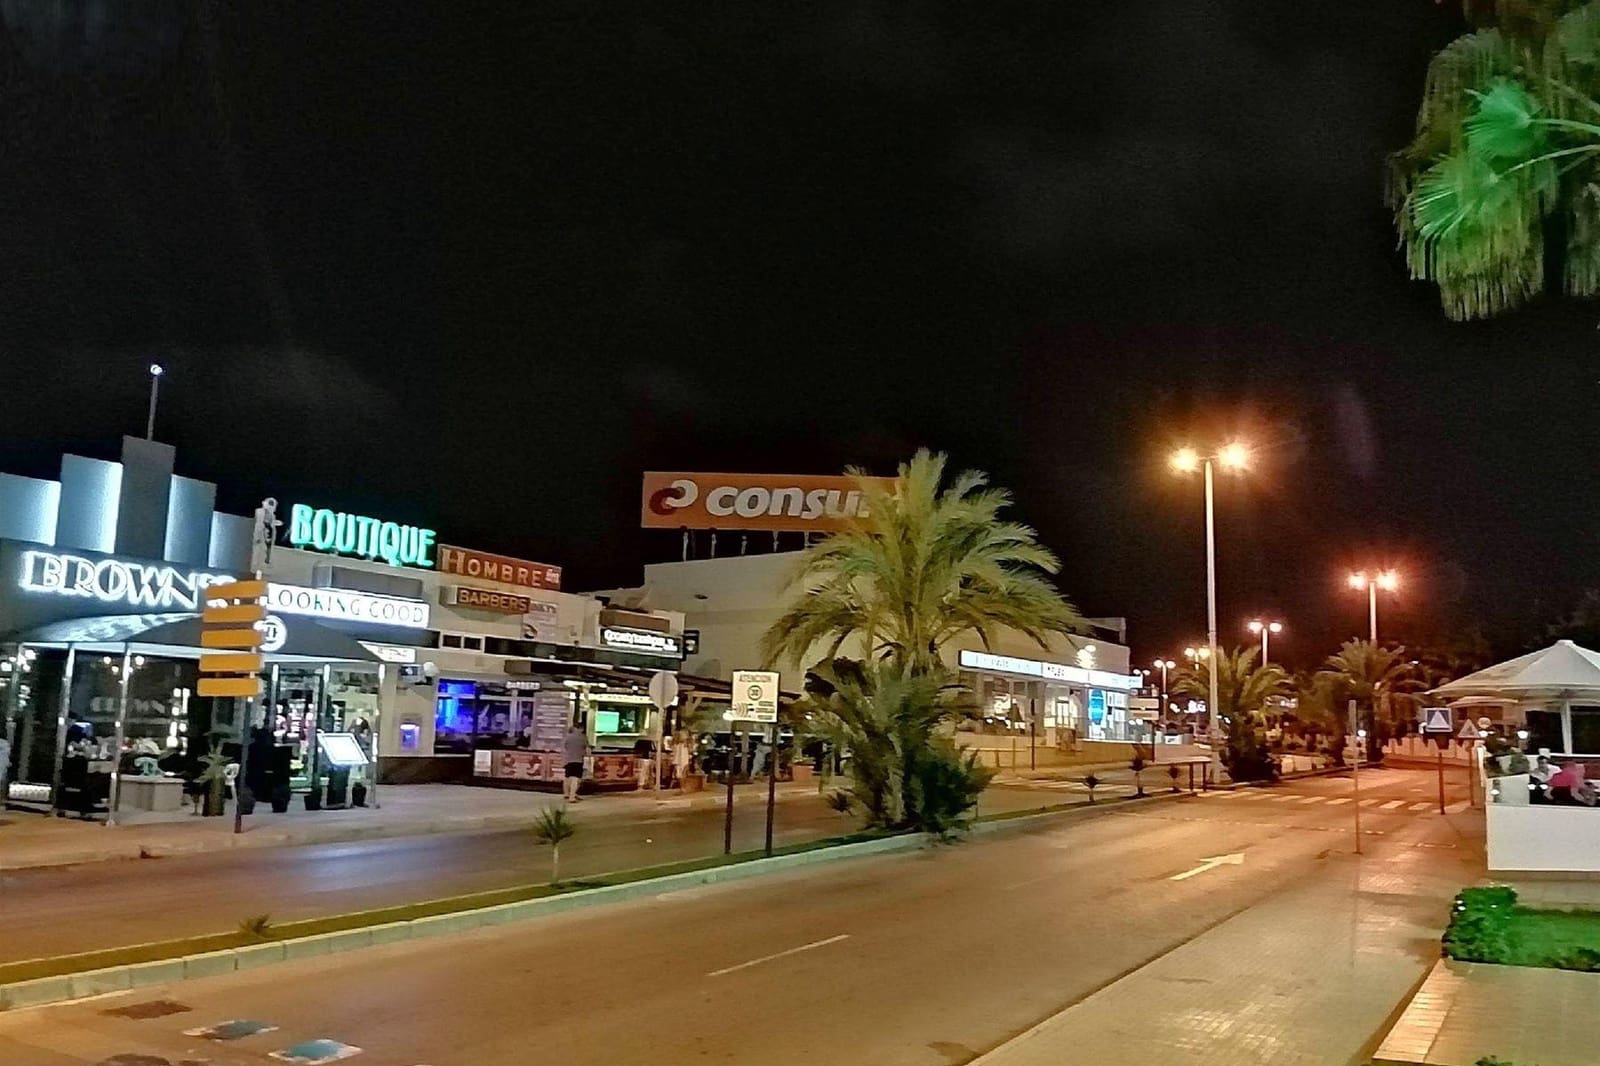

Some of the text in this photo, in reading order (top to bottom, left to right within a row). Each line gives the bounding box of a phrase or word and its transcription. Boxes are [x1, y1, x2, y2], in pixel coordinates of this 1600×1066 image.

[706, 486, 870, 520] consu
[290, 503, 436, 568] BOUTIQUE
[441, 548, 542, 586] HOMBRE
[368, 600, 425, 624] GOOD
[458, 589, 528, 611] BARBERS
